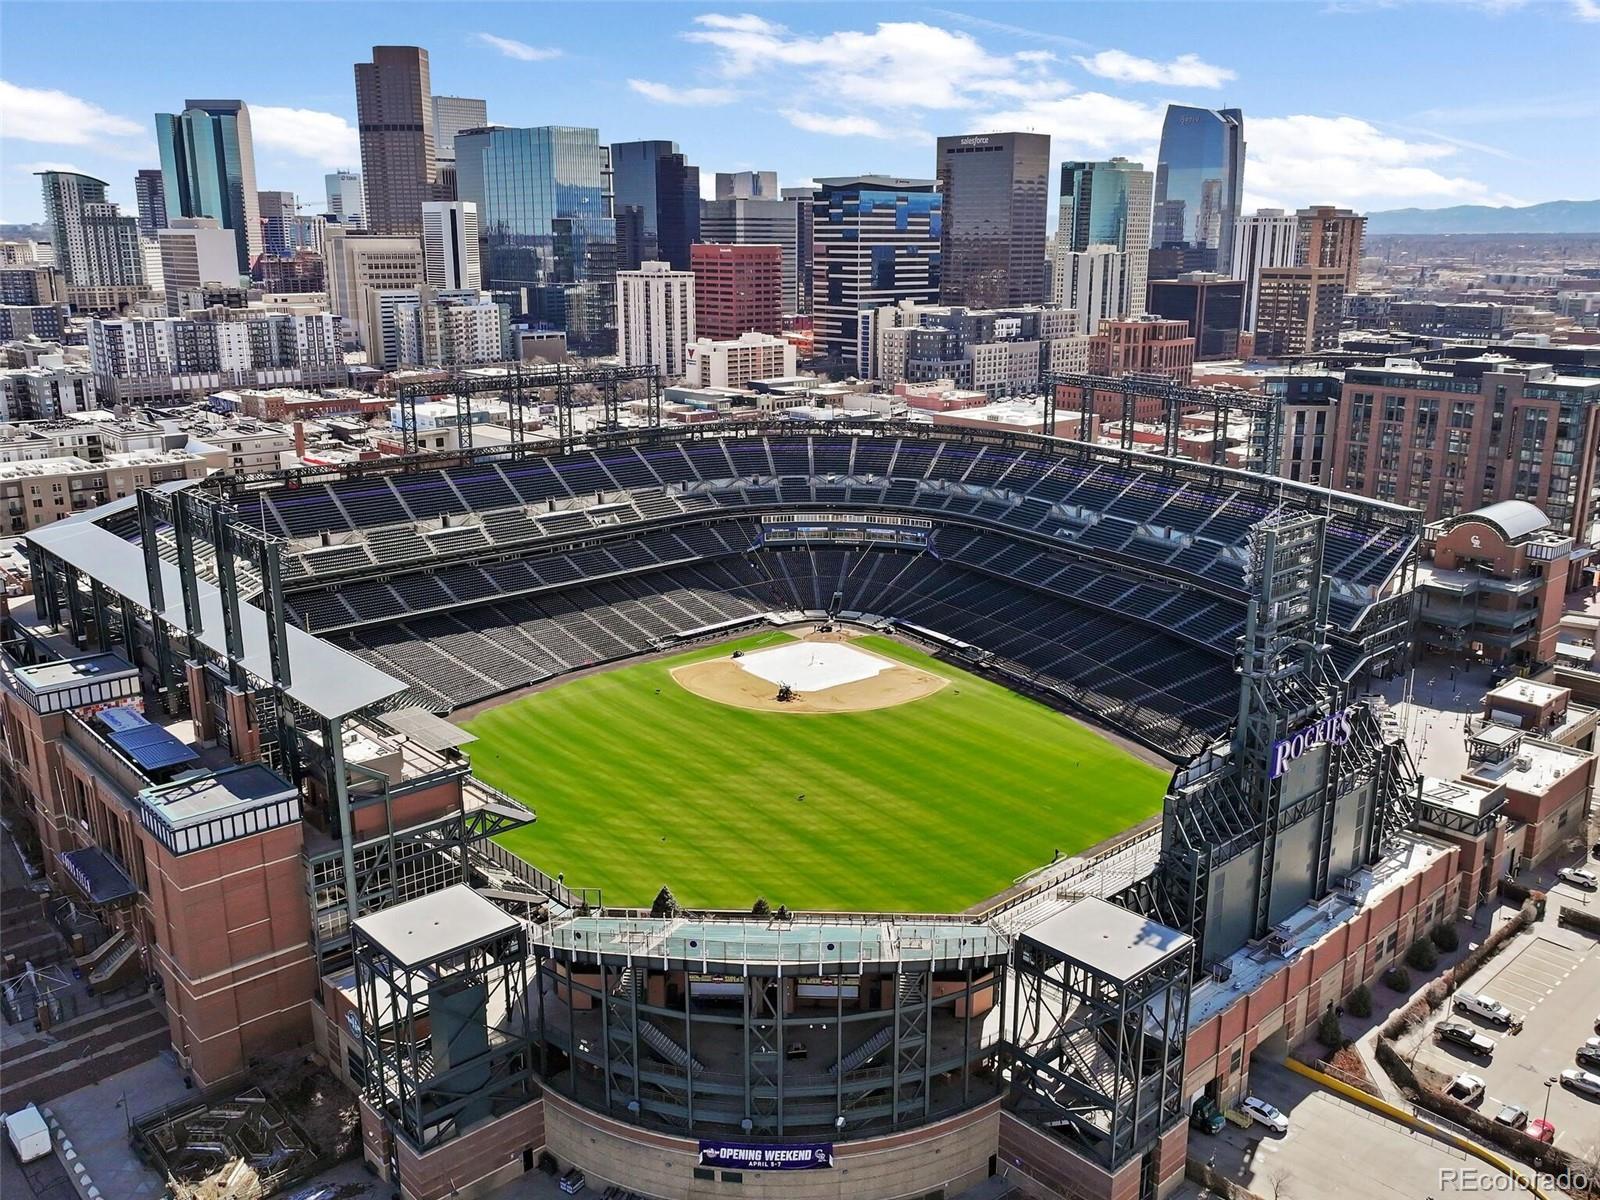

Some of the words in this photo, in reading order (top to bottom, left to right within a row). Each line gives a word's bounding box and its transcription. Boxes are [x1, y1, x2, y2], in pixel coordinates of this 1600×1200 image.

[1269, 707, 1352, 780] ROCKIES
[719, 1147, 762, 1161] OPENING
[764, 1149, 812, 1161] WEEKEND
